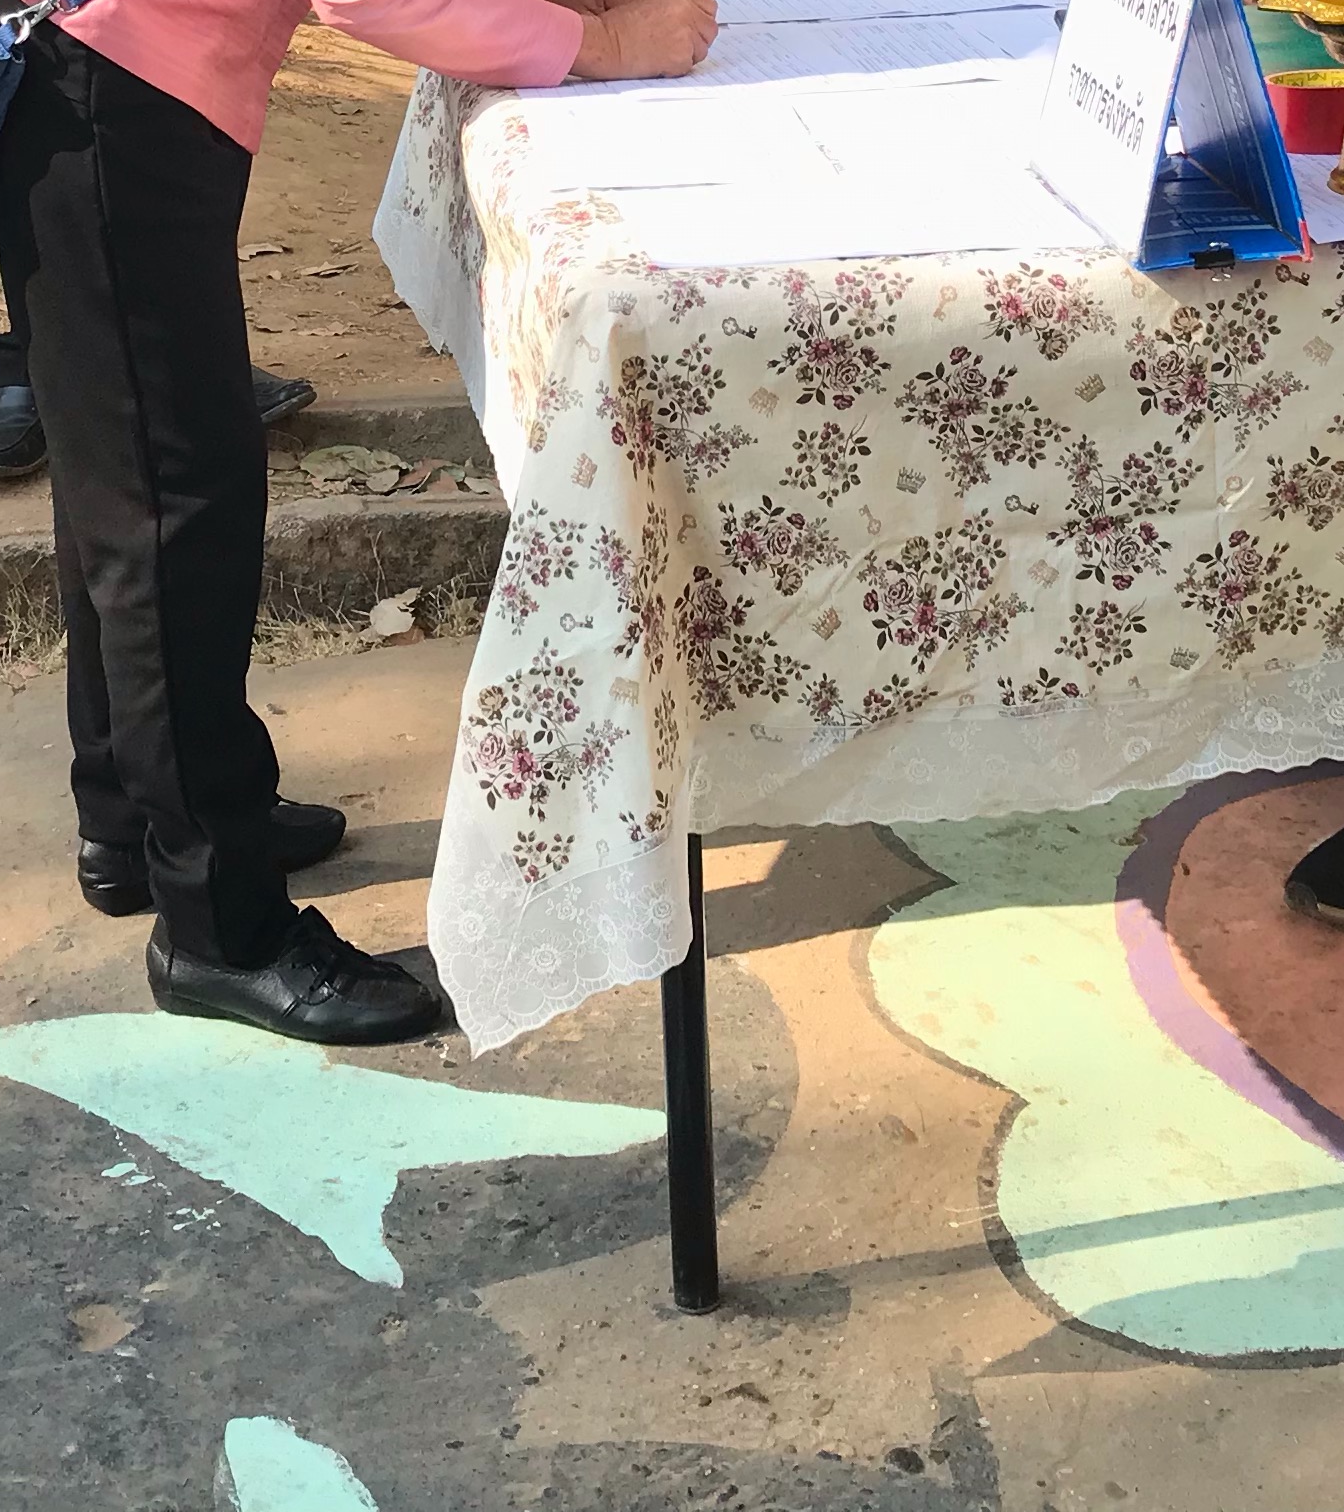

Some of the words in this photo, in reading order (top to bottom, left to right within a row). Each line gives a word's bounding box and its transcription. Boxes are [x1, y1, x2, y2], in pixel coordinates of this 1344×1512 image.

[1068, 63, 1145, 155] ราชการจังหวัด
